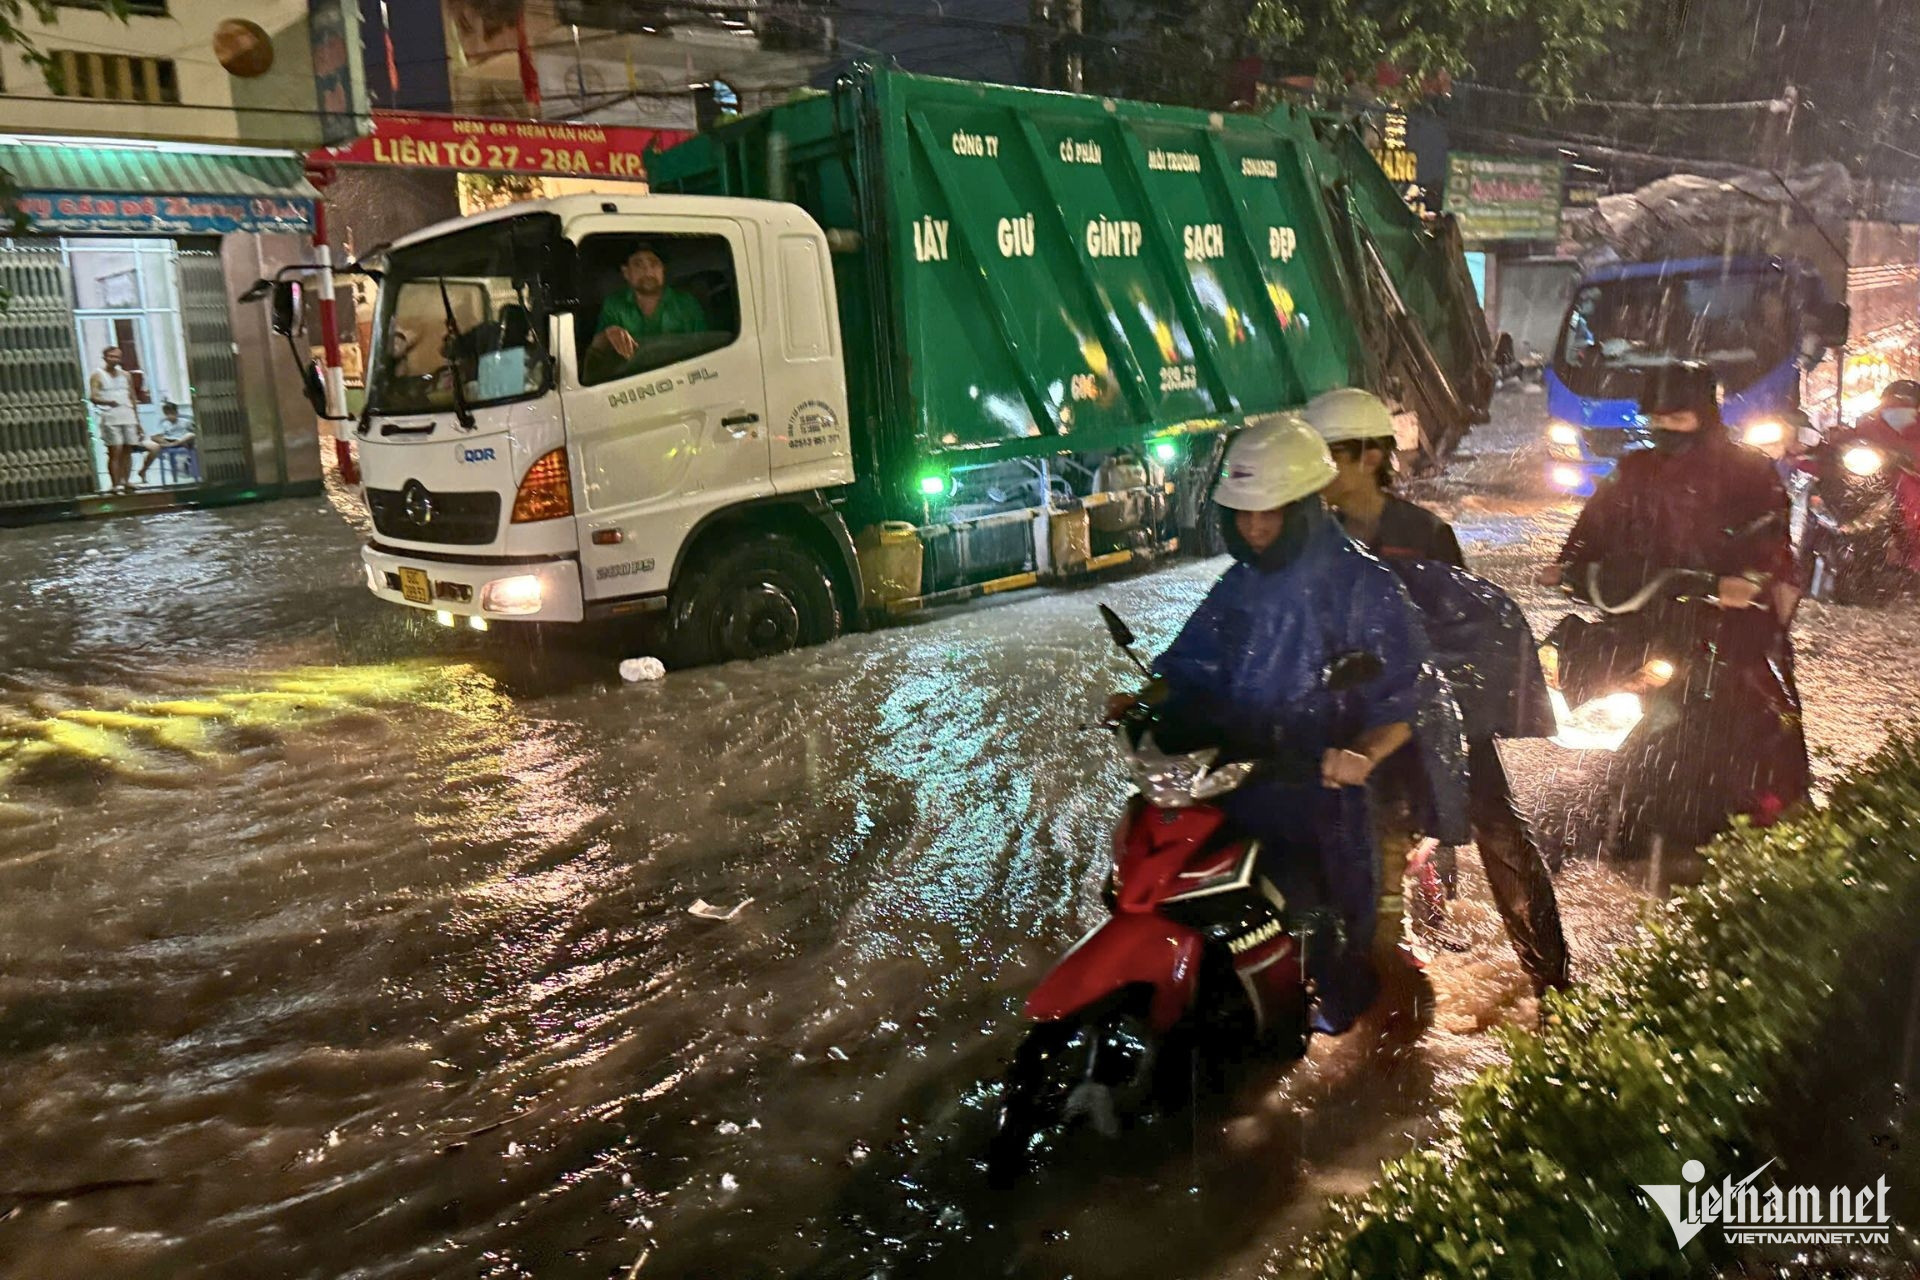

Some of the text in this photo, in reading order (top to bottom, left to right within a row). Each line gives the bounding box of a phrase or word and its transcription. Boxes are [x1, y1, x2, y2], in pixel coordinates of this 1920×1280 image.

[372, 135, 438, 166] LIÊN
[442, 135, 482, 167] TỔ
[486, 145, 519, 169] 27
[540, 148, 592, 174] 28A
[952, 128, 984, 157] CÔNG
[985, 135, 998, 158] TY
[1184, 224, 1224, 262] SẠCH
[464, 448, 496, 462] QDR
[1227, 918, 1282, 954] YAMAHA
